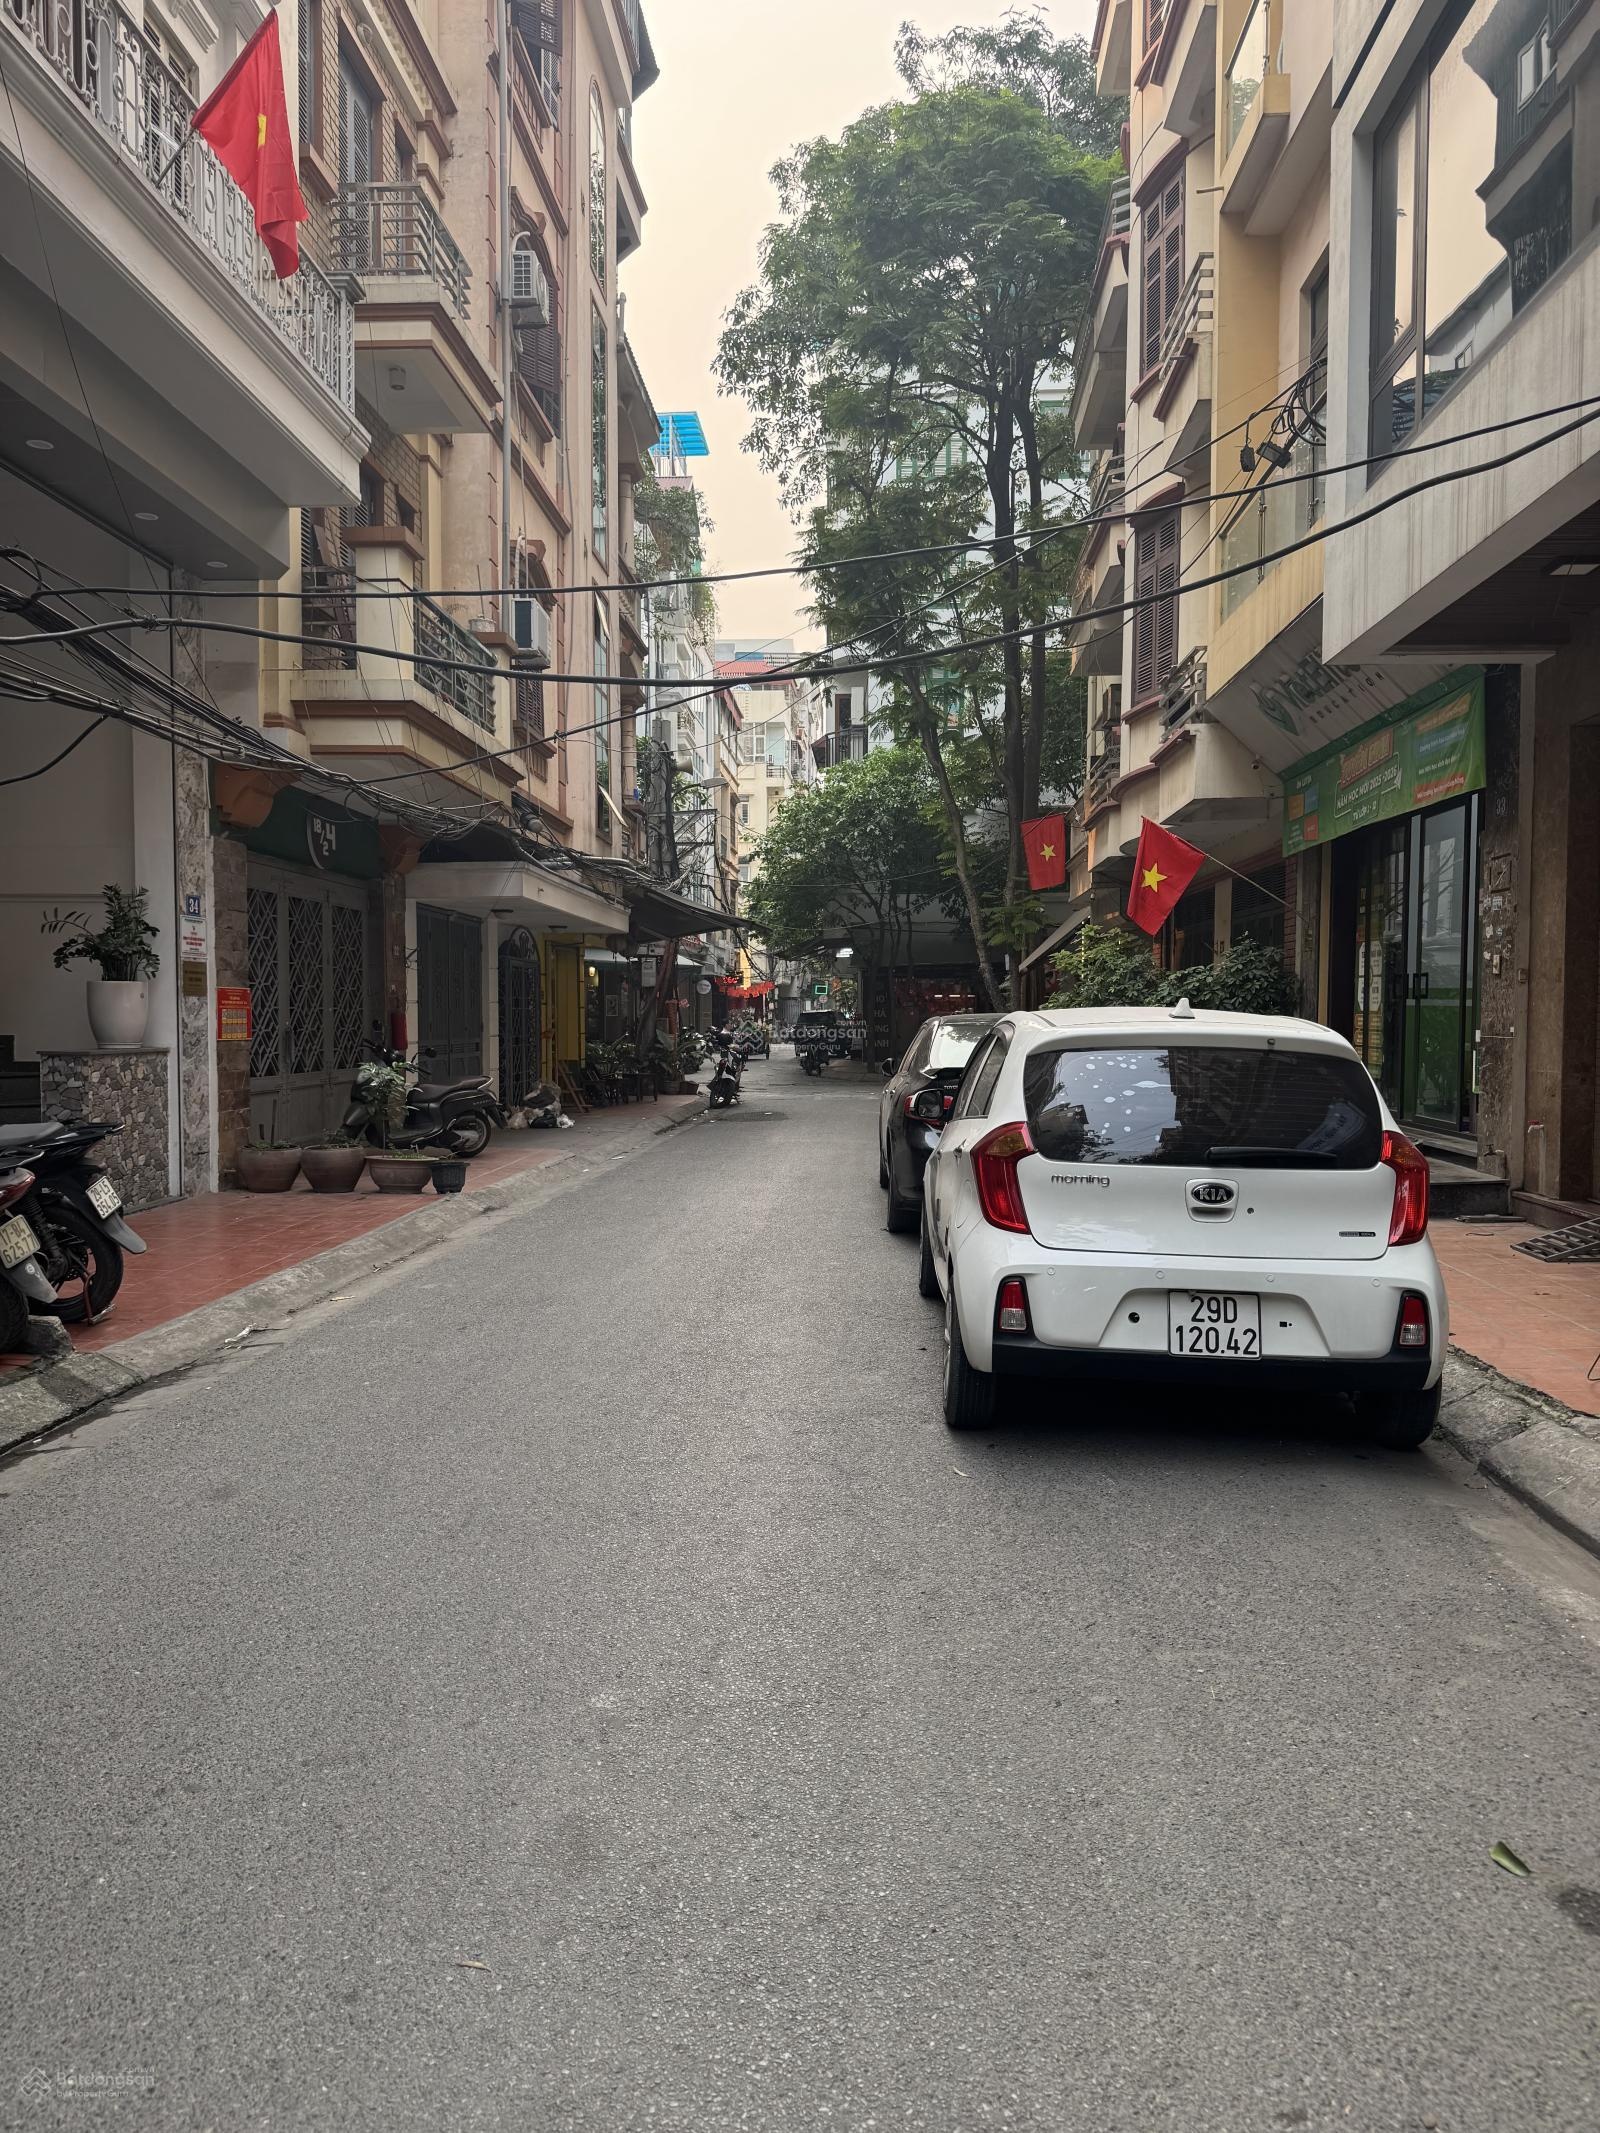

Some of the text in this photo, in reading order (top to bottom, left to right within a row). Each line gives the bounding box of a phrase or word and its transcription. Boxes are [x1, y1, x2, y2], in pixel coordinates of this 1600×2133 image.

[189, 898, 199, 914] 34
[1051, 1174, 1110, 1188] morning
[1199, 1188, 1228, 1201] KIA
[3, 1232, 36, 1264] 625.77
[1191, 1295, 1238, 1324] 29D
[1175, 1325, 1258, 1356] 120.42
